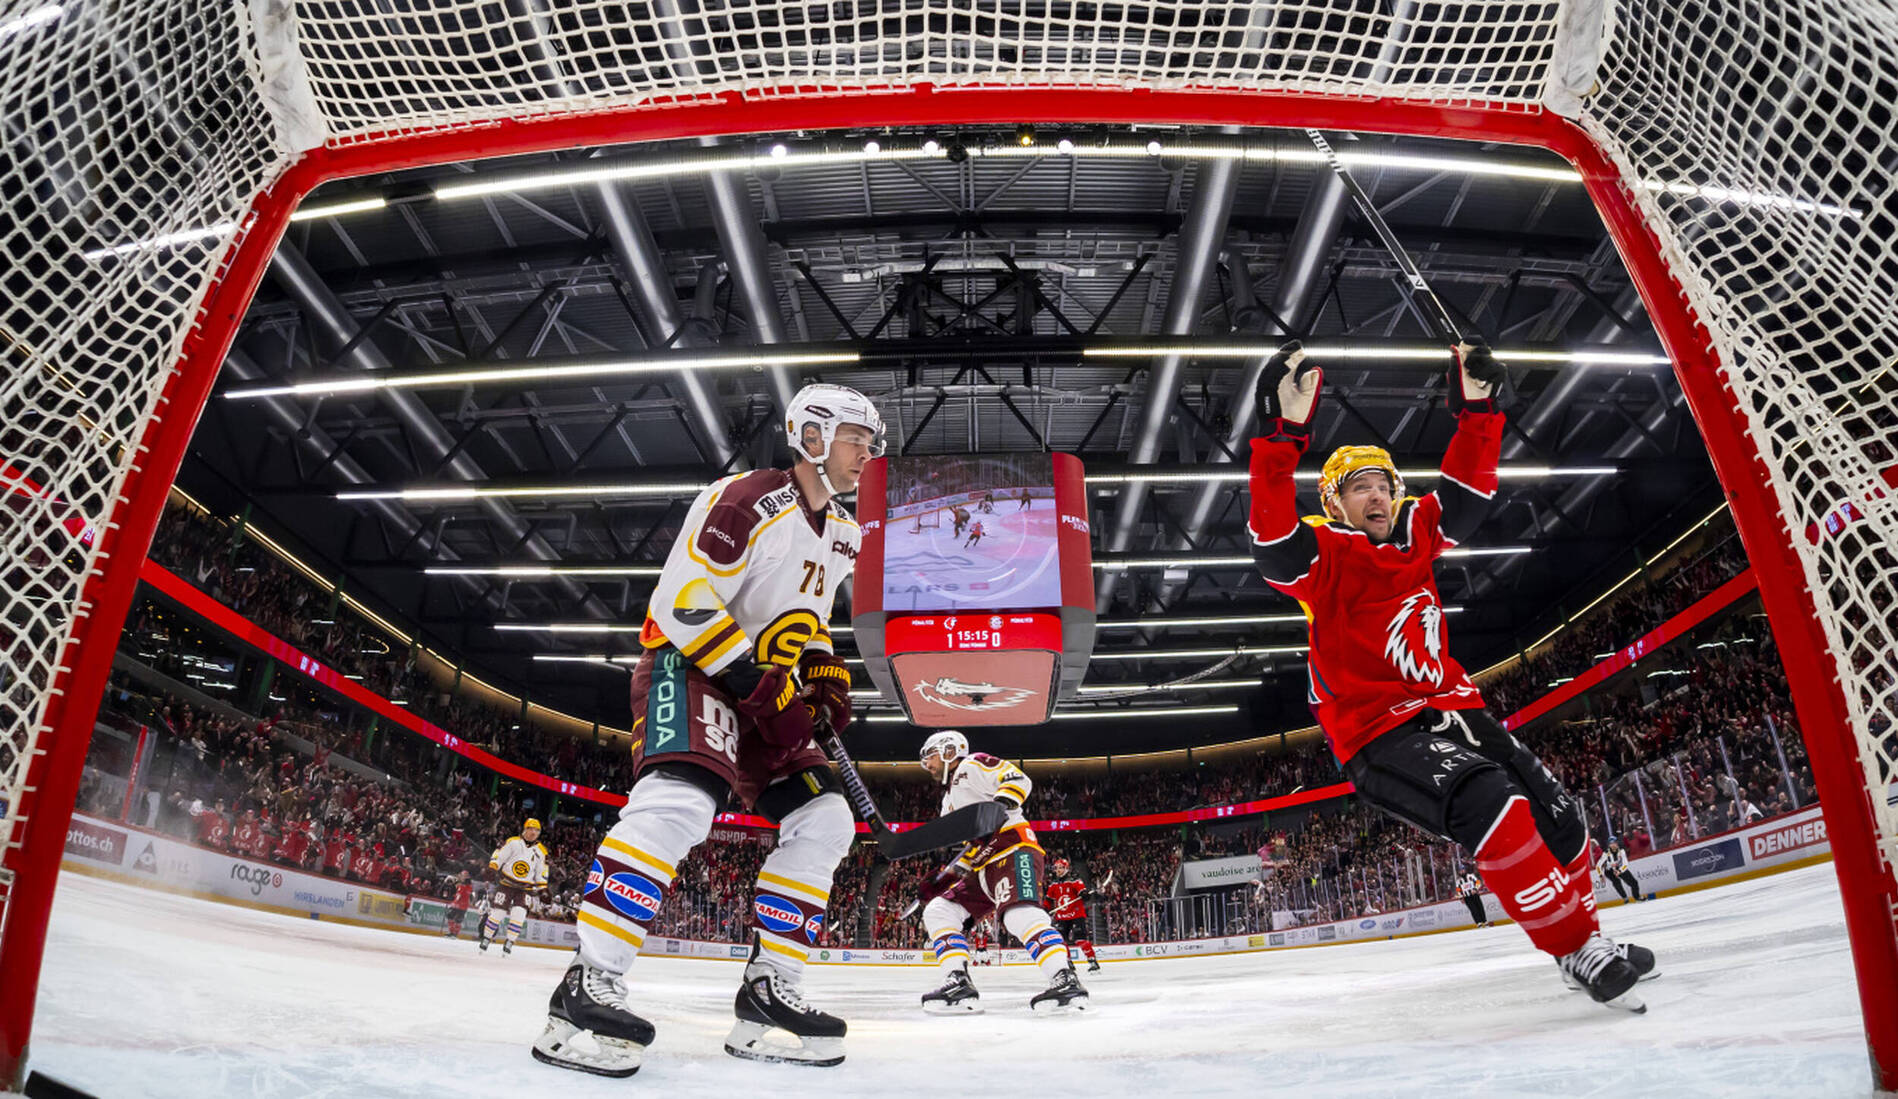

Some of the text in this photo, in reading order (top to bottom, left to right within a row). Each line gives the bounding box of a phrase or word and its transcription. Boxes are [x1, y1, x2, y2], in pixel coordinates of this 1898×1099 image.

[946, 630, 1001, 649] 1 15:15 0
[708, 829, 748, 841] ANSHOP
[1753, 818, 1827, 857] DENNER
[1145, 946, 1168, 956] BCV
